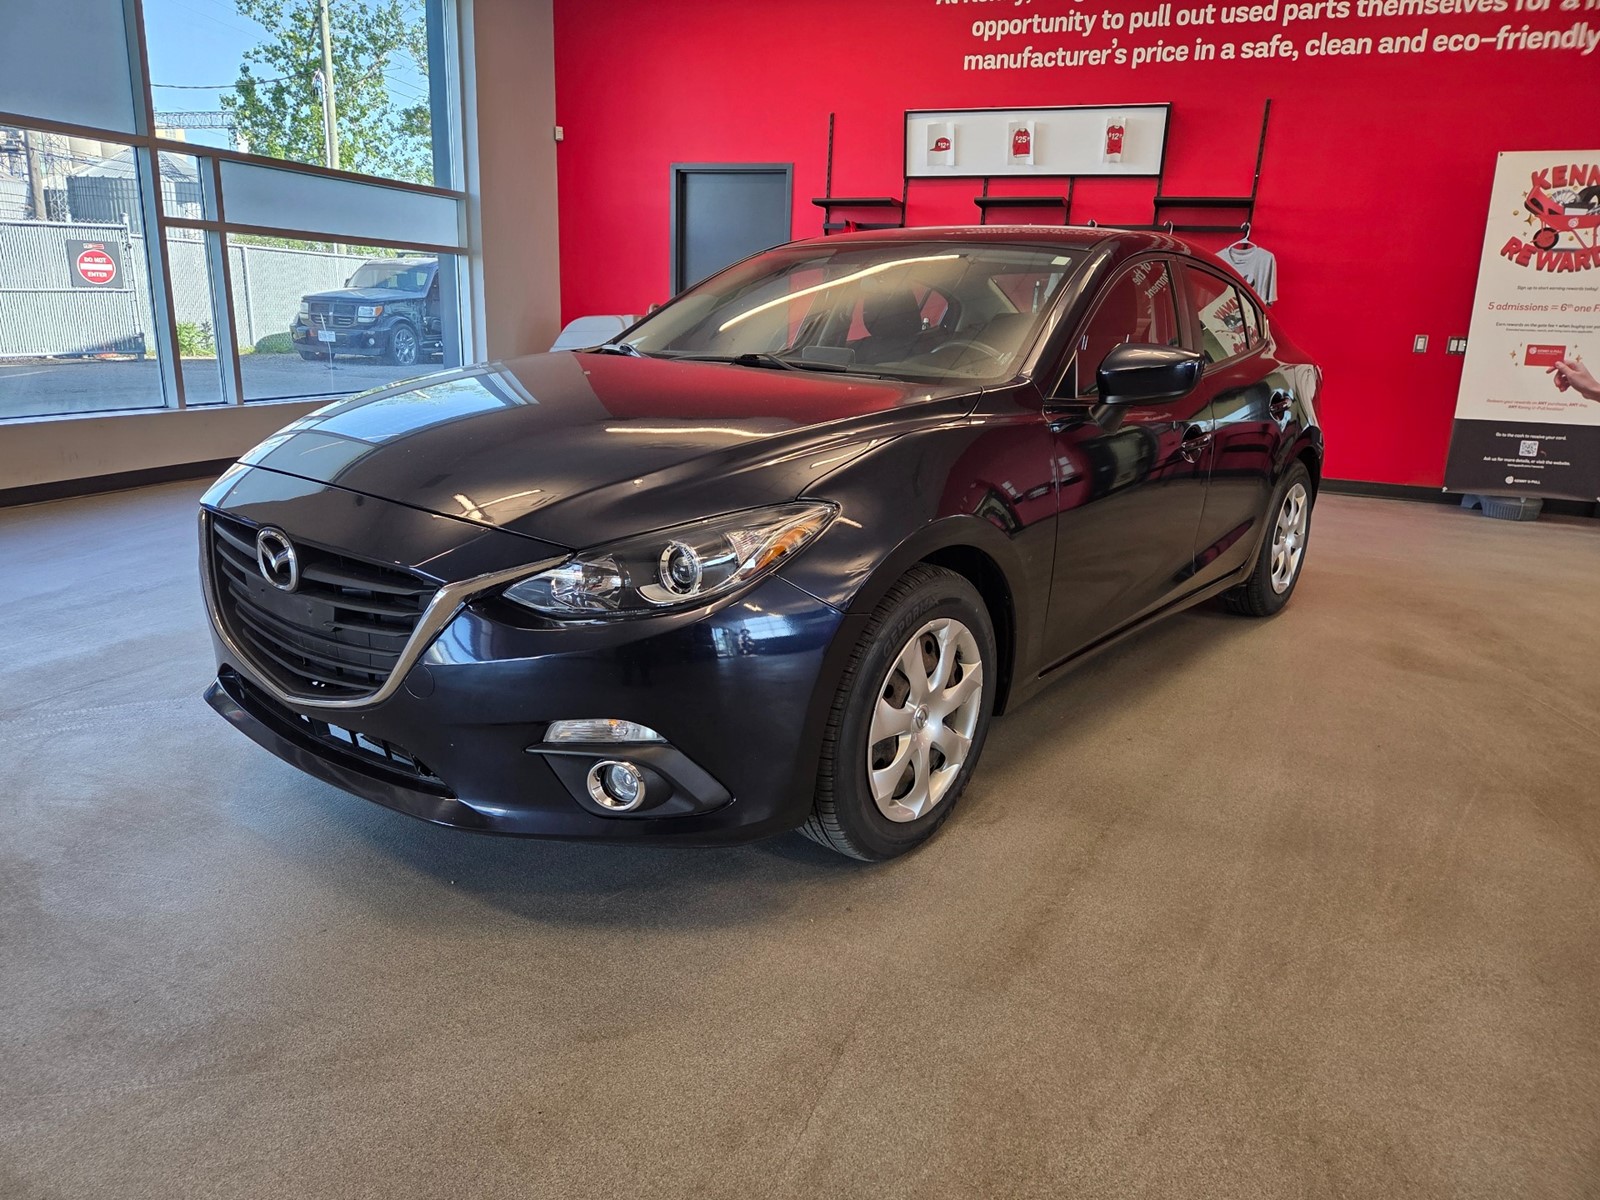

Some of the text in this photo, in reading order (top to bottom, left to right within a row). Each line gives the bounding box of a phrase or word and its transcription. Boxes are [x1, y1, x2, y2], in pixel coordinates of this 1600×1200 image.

[972, 9, 1097, 41] opportunity
[1102, 10, 1125, 30] to
[1128, 3, 1171, 34] pull
[1176, 4, 1216, 26] out
[1220, 0, 1278, 24] used
[1282, 0, 1350, 27] parts
[1357, 0, 1508, 17] themselves
[963, 38, 1127, 70] manufacturer's
[1131, 40, 1189, 69] price
[1194, 37, 1215, 61] in
[1220, 42, 1235, 60] a
[1240, 34, 1299, 61] safe,
[1305, 32, 1372, 56] clean
[1378, 28, 1428, 54] and
[1488, 302, 1495, 310] 5
[1496, 302, 1549, 312] admissions
